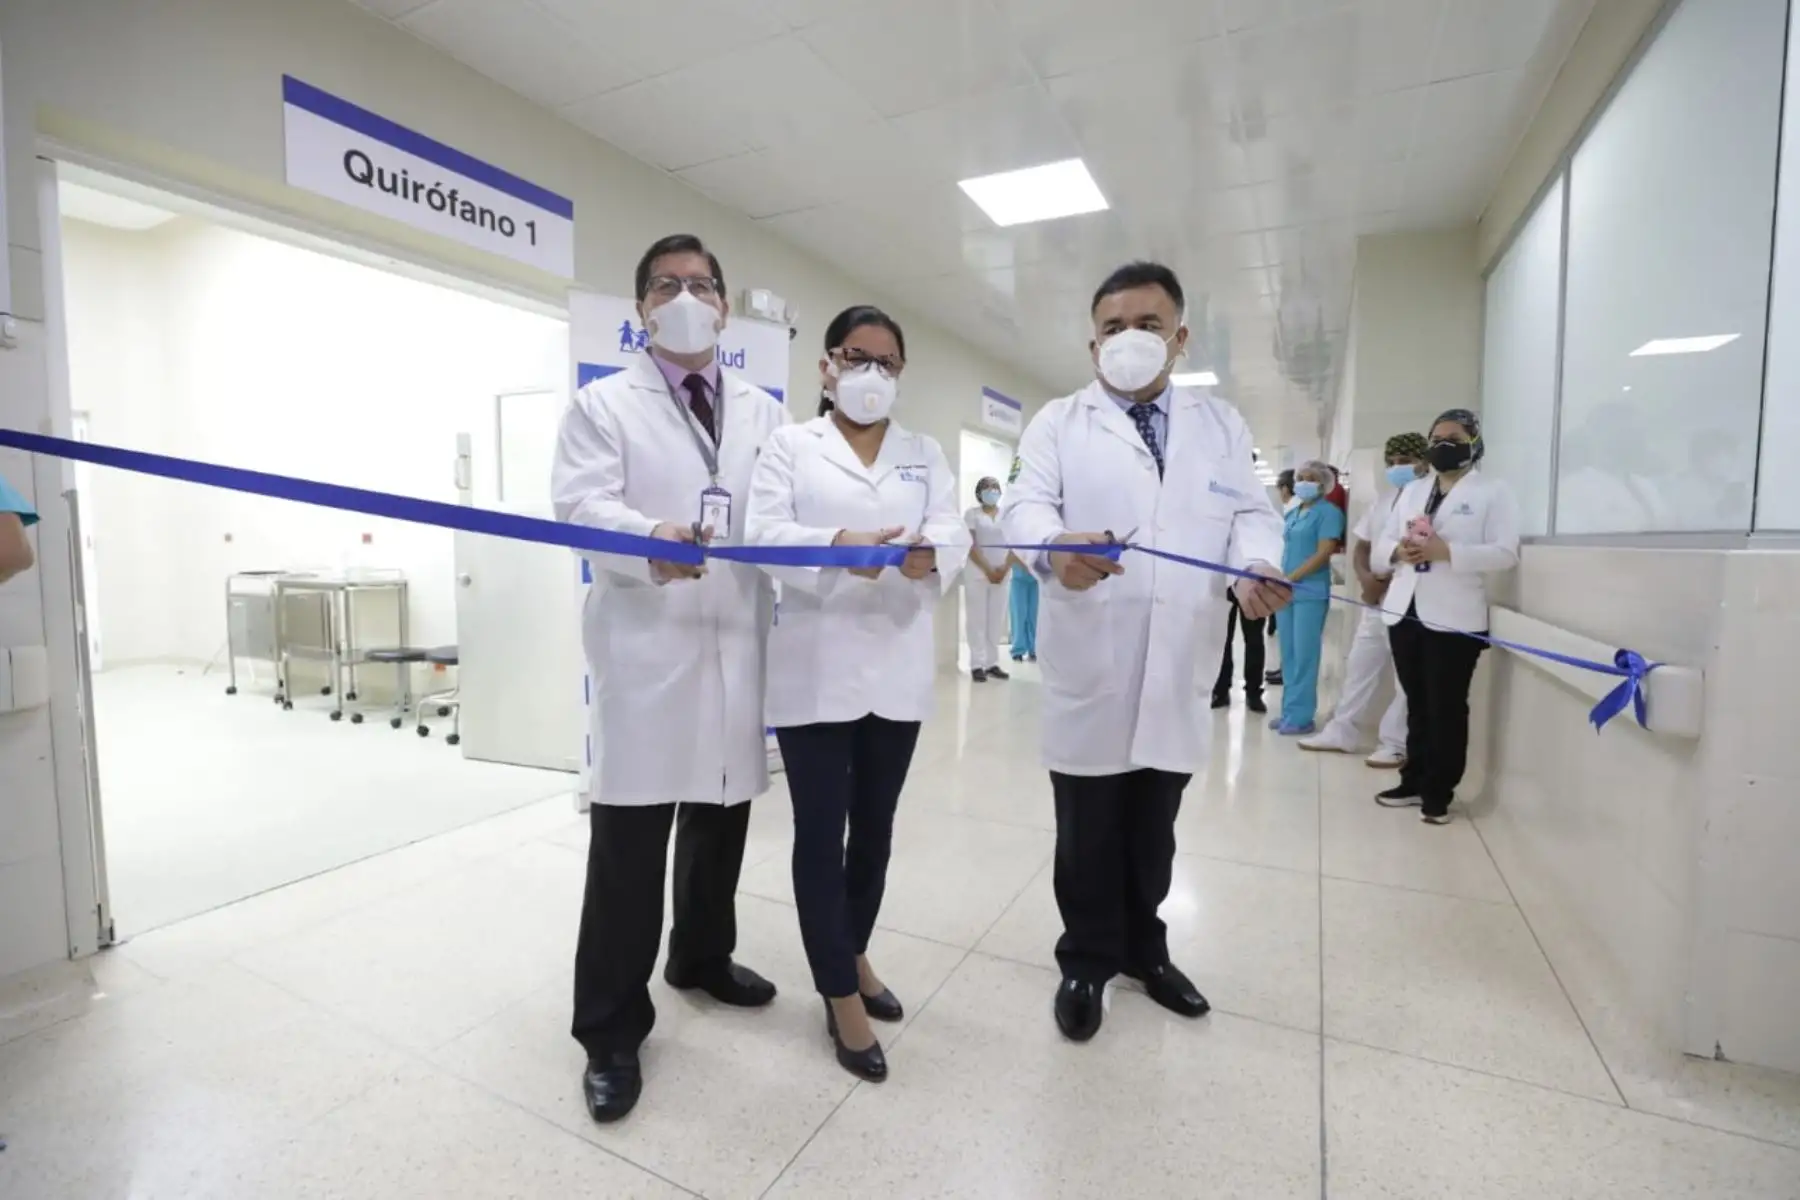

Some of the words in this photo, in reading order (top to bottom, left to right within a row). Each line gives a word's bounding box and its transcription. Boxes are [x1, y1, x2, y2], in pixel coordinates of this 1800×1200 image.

[343, 148, 516, 238] Quirófano
[524, 219, 537, 247] 1
[715, 344, 746, 370] lud
